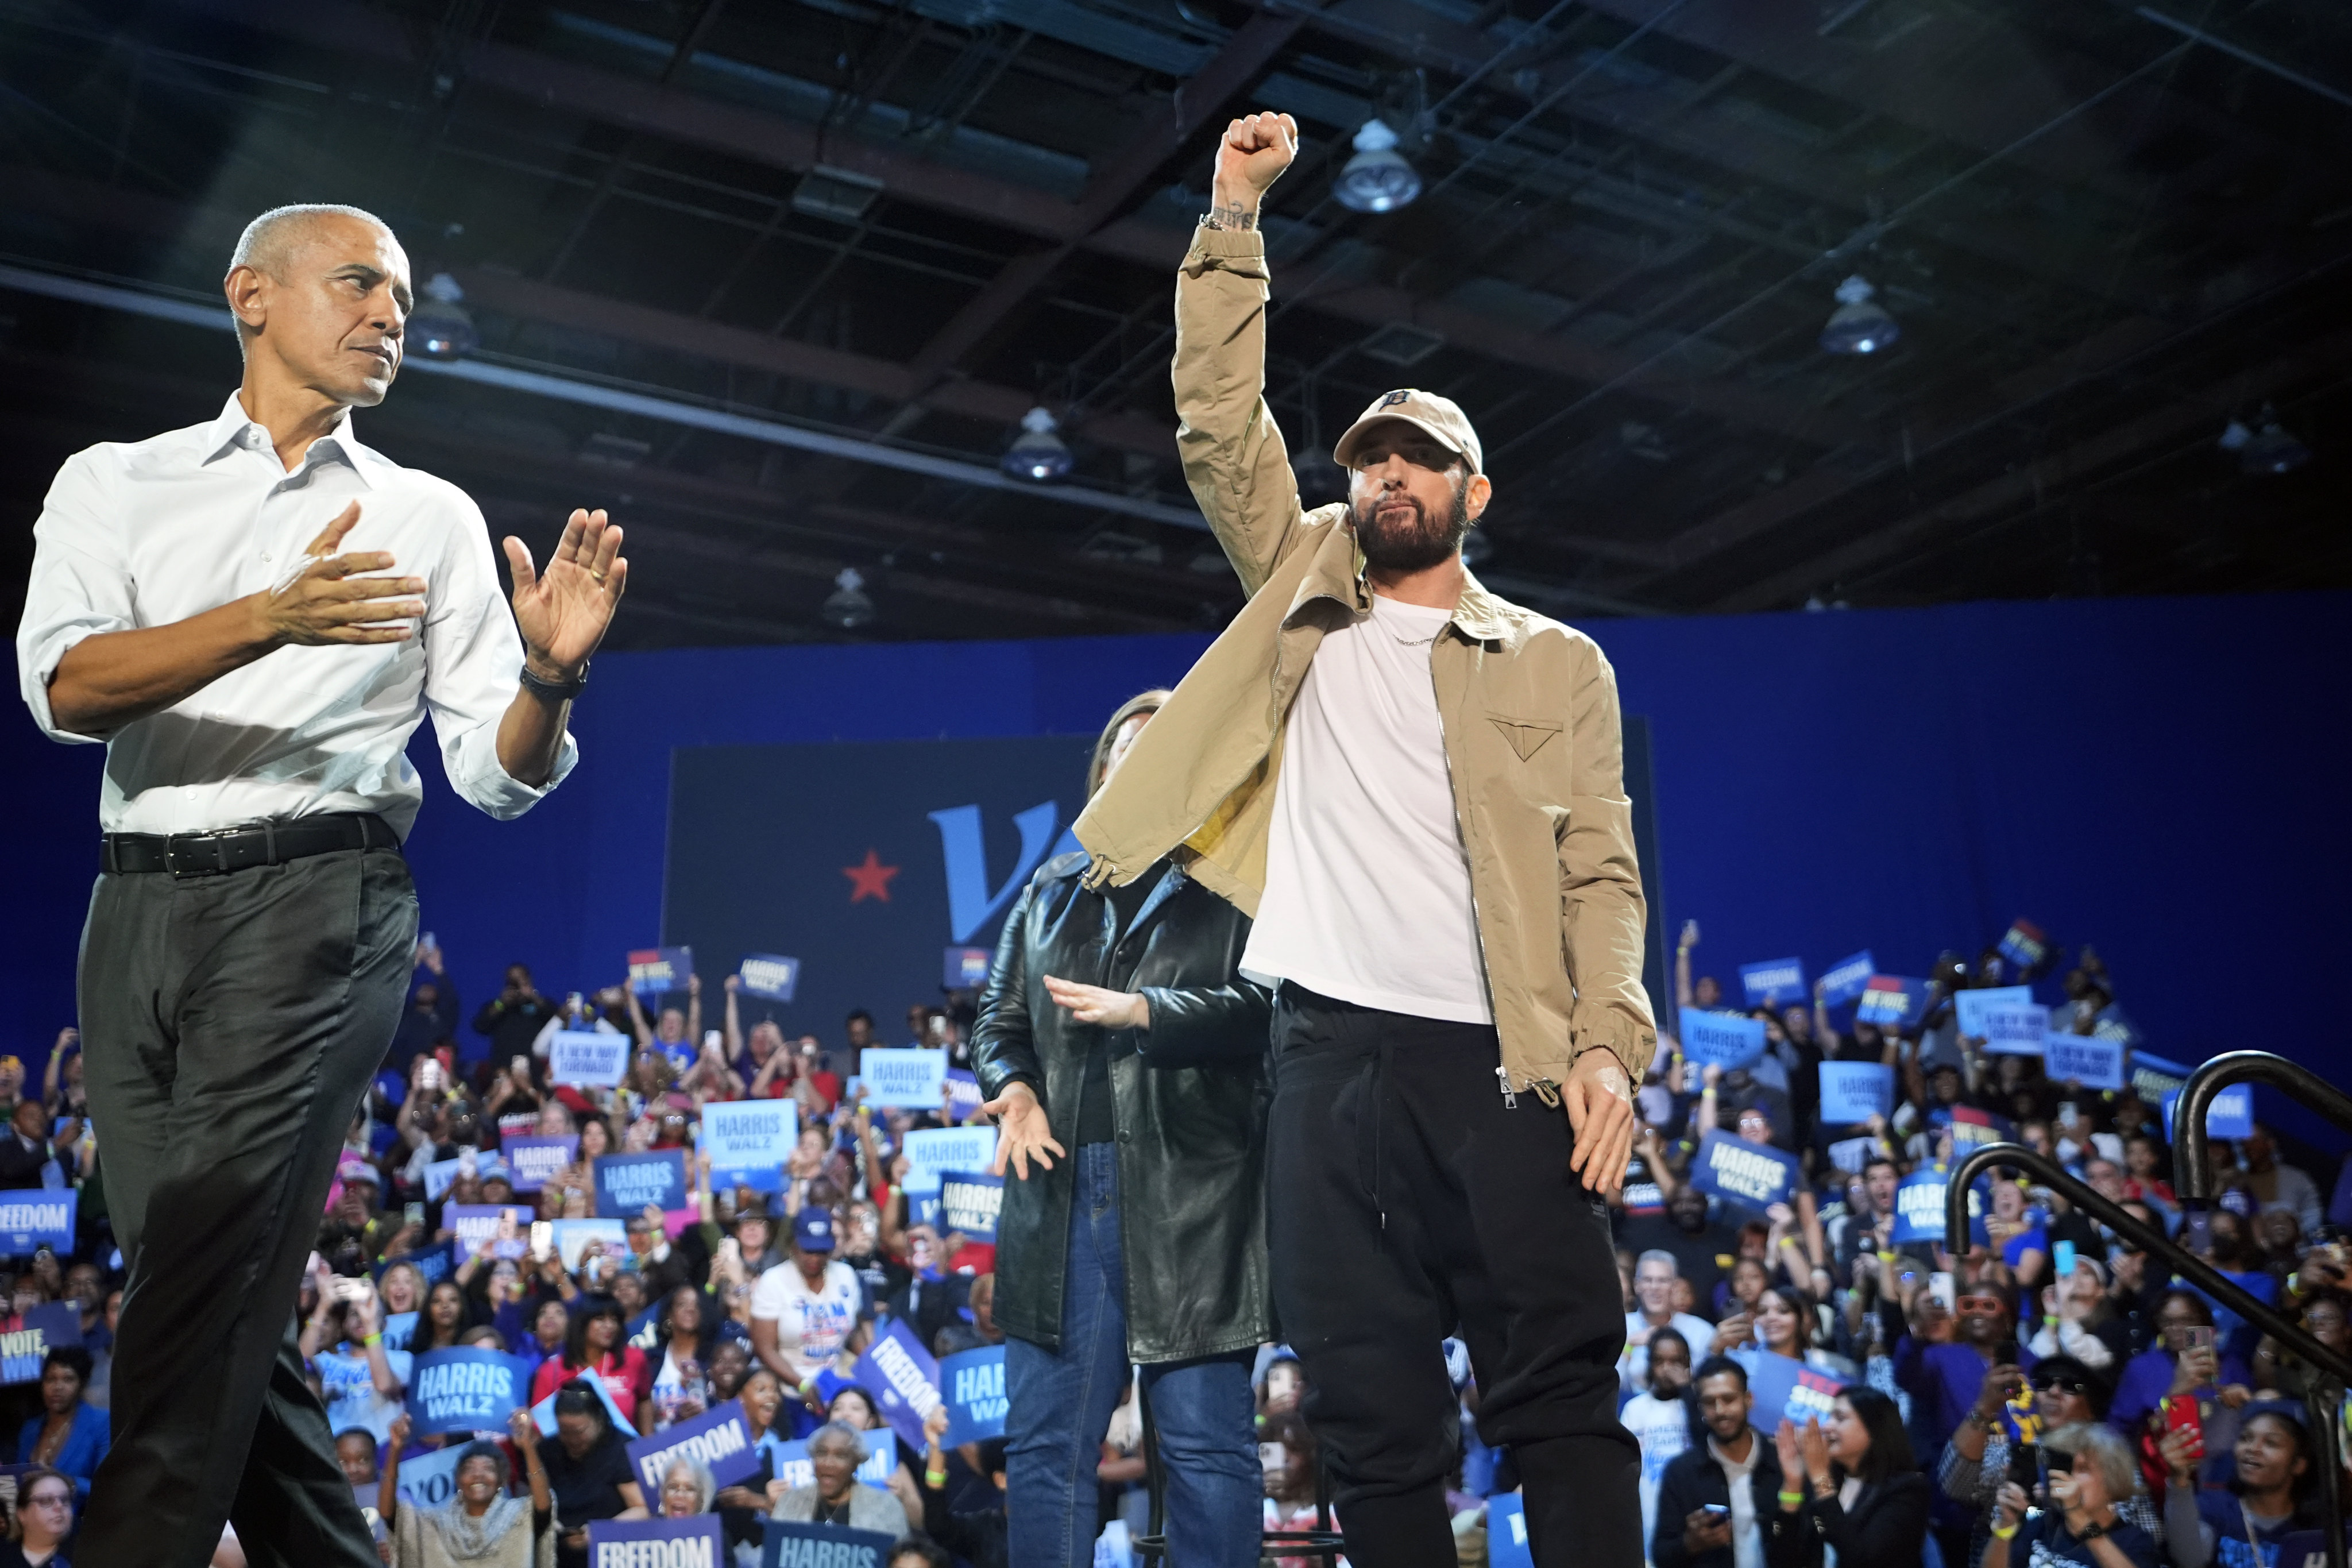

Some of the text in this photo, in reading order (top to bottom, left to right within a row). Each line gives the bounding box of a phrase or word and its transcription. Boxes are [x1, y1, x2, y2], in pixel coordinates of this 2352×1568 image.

[740, 959, 790, 985] HARRIS
[1694, 1026, 1746, 1049] HARRIS
[873, 1061, 932, 1080] HARRIS
[882, 1082, 922, 1094] WALZ
[716, 1112, 781, 1138] HARRIS
[727, 1136, 771, 1151] WALZ
[916, 1140, 979, 1162] HARRIS
[513, 1145, 569, 1169] HARRIS
[1709, 1141, 1787, 1190] HARRIS
[604, 1161, 675, 1192] HARRIS
[1717, 1170, 1769, 1202] WALZ
[615, 1186, 665, 1207] WALZ
[0, 1203, 68, 1233] EEDOM
[948, 1210, 995, 1233] WALZ
[0, 1327, 50, 1360] VOTE,
[417, 1362, 514, 1404] HARRIS
[427, 1395, 494, 1421] WALZ
[597, 1535, 714, 1568] FREEDOM
